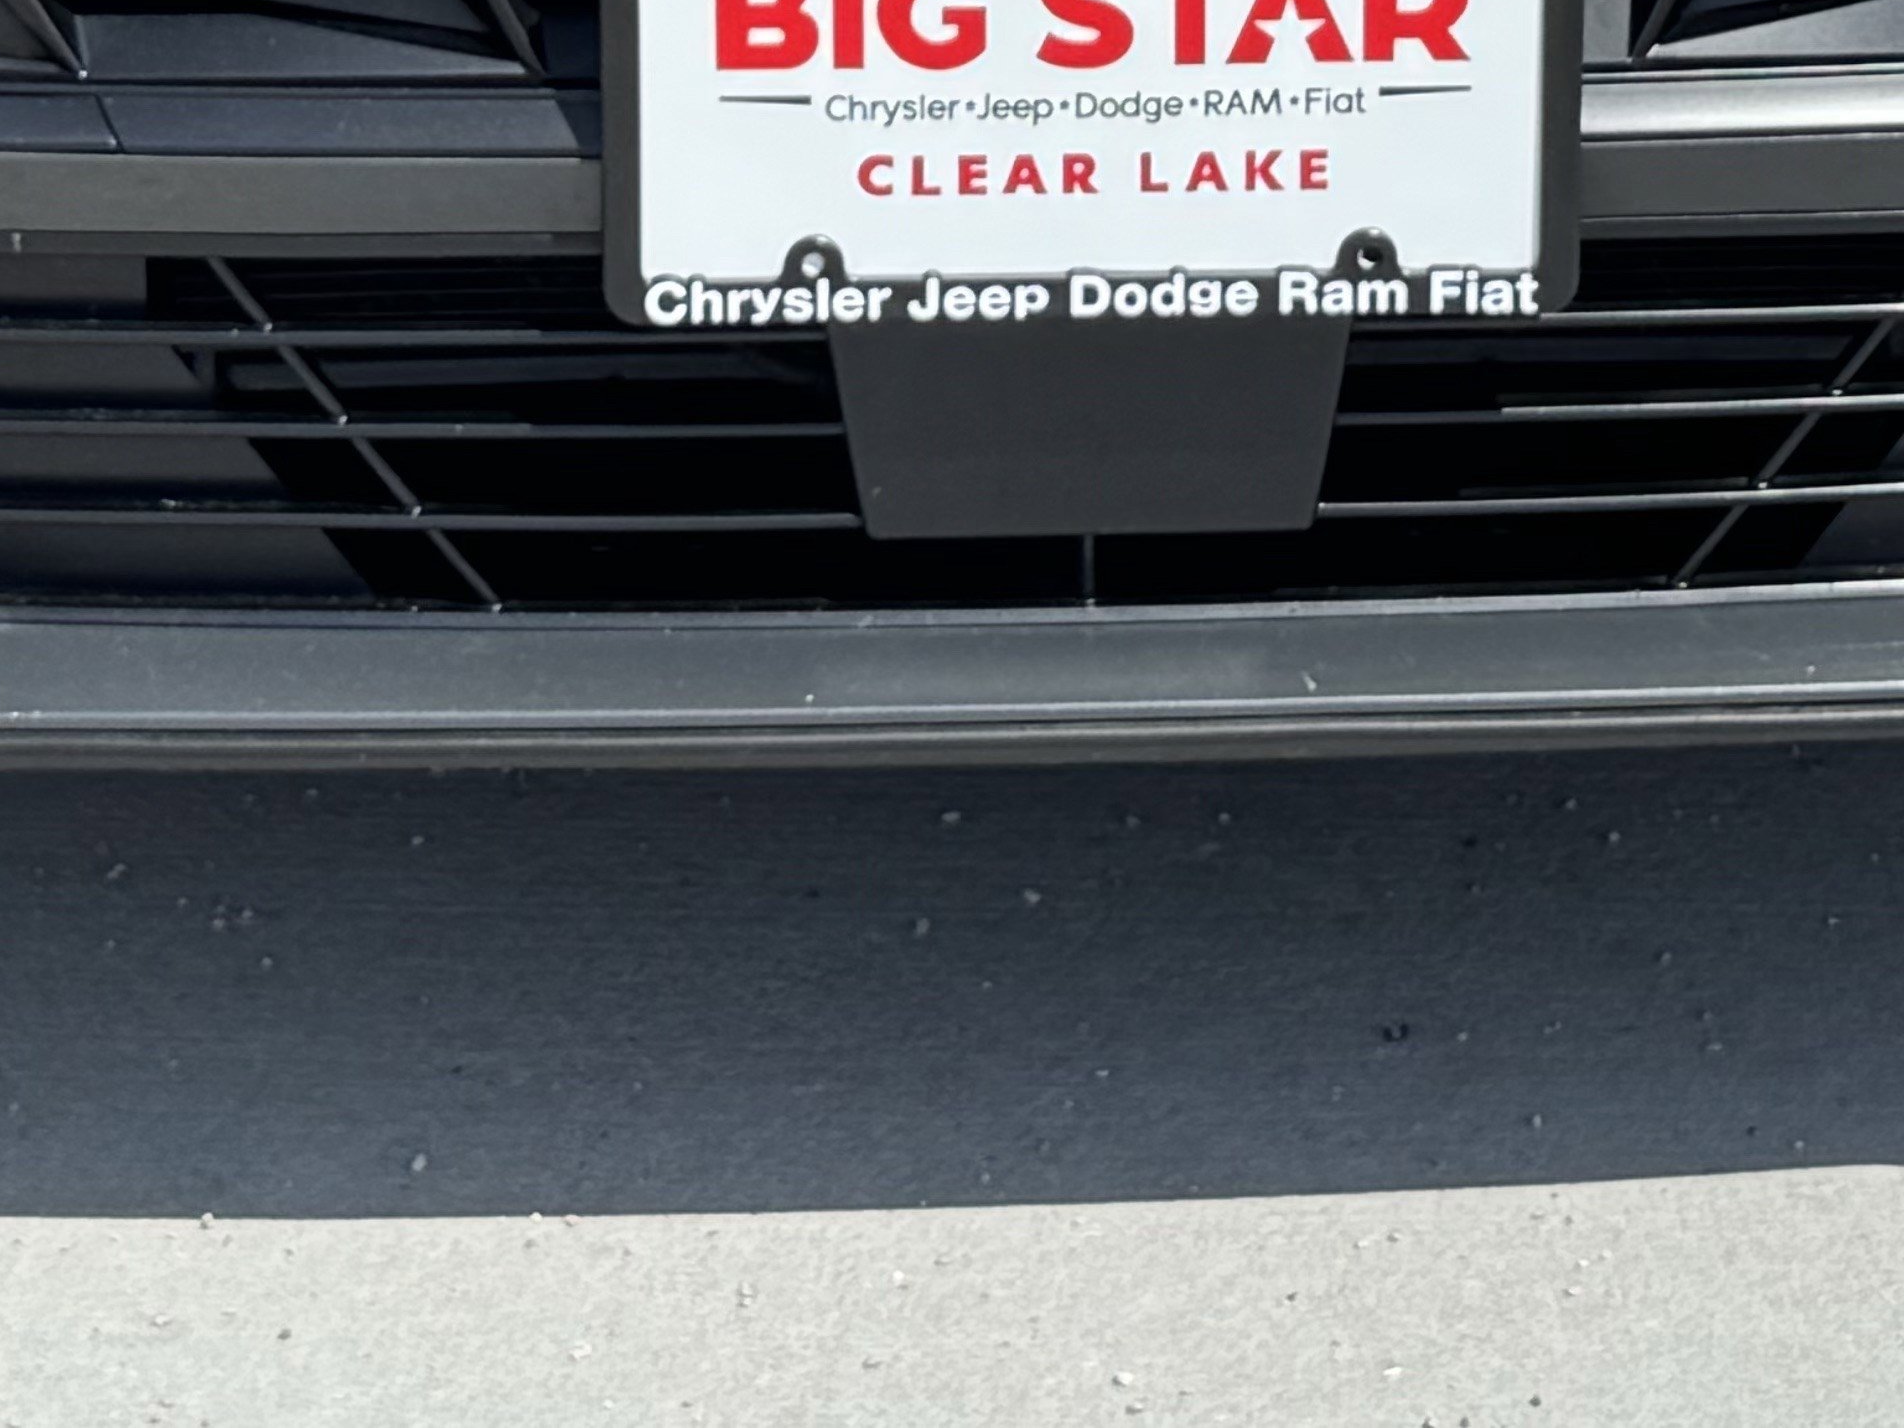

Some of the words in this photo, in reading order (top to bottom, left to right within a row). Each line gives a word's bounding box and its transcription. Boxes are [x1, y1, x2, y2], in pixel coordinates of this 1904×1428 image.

[856, 152, 1100, 197] CLEAR
[1139, 148, 1330, 194] LAKE
[643, 276, 893, 326] Chrysler
[906, 272, 1051, 322] Jeep
[1068, 272, 1260, 319] Dodge
[1278, 270, 1409, 317] Ram
[1429, 268, 1541, 316] Fiat
